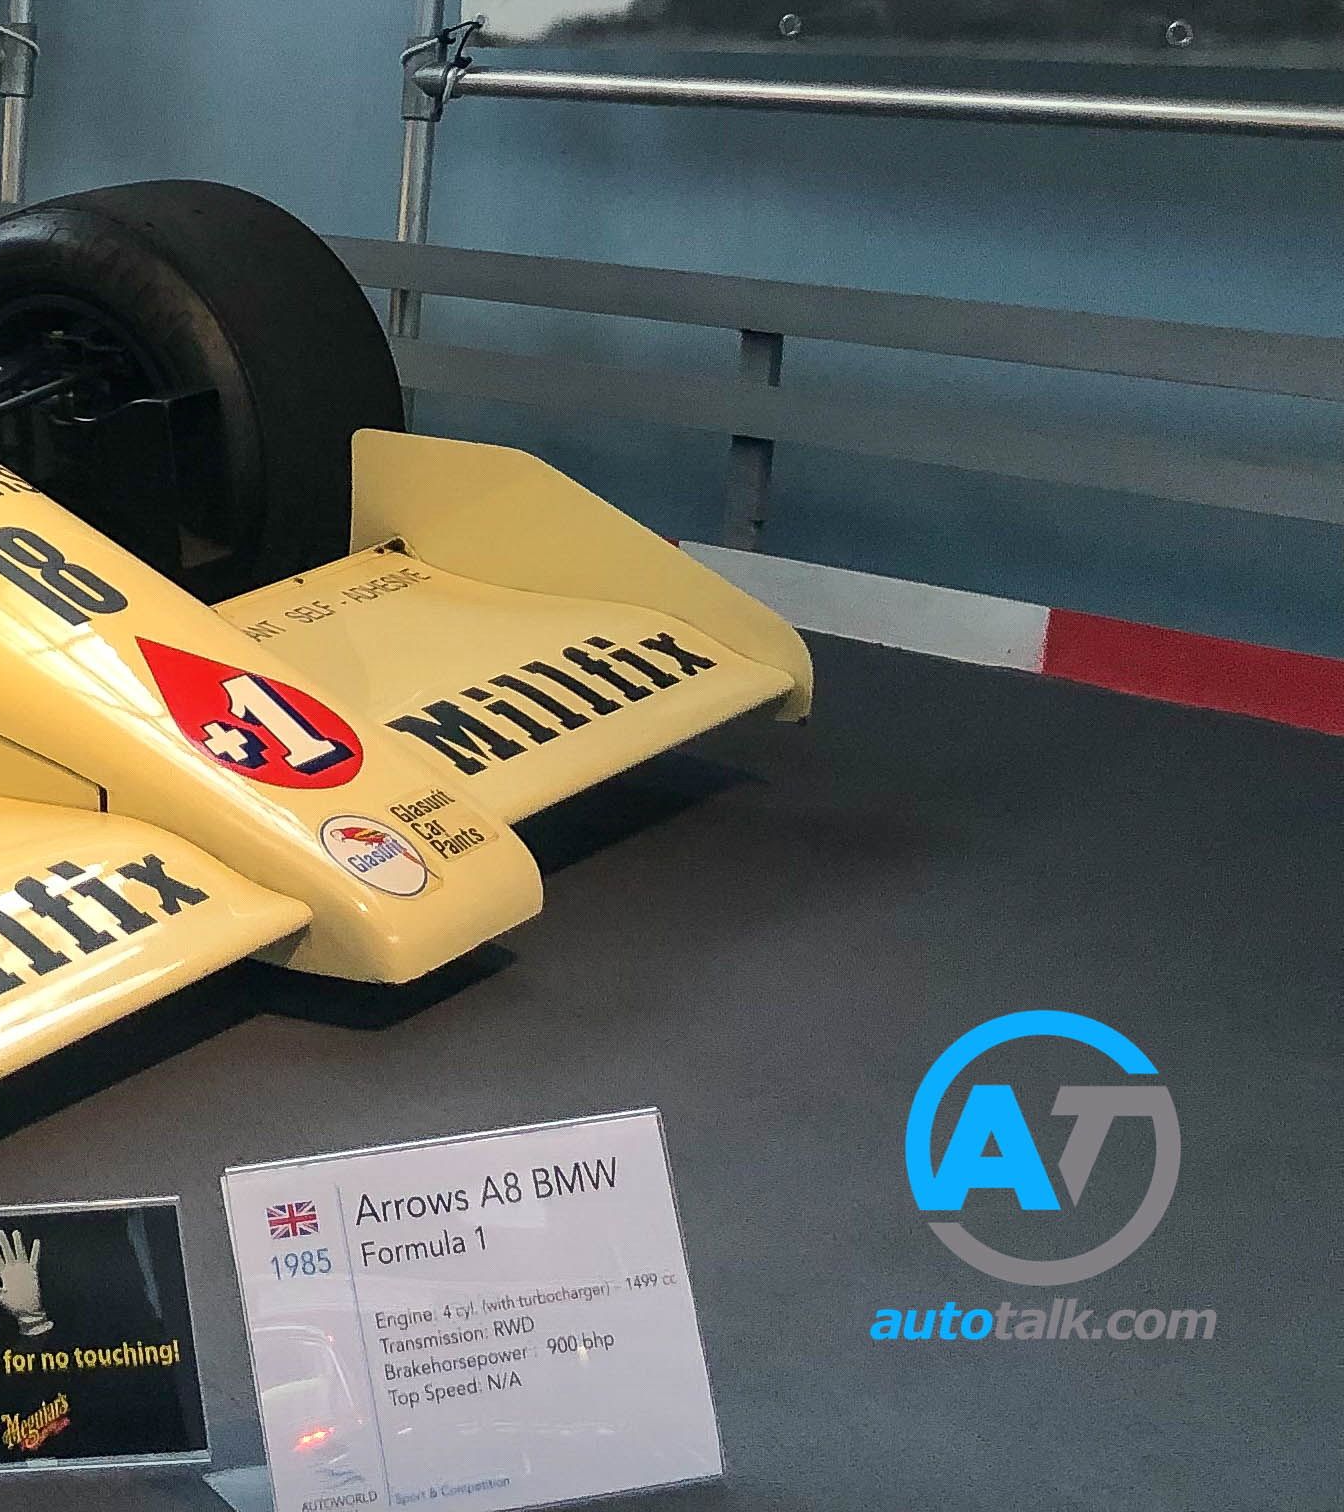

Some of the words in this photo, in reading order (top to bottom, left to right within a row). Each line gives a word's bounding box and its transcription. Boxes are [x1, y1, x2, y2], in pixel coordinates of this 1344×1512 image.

[284, 600, 334, 625] SELF
[350, 568, 432, 605] ADHESIVE
[385, 631, 718, 776] Millfix
[200, 673, 355, 775] +1
[410, 818, 448, 841] Car
[429, 826, 485, 860] Paints
[356, 1189, 469, 1226] Arrows
[480, 1172, 523, 1208] A8
[532, 1157, 617, 1199] BMW
[270, 1248, 333, 1281] 1985
[362, 1230, 467, 1267] Formula
[475, 1225, 487, 1250] 1
[443, 1304, 452, 1319] 4
[483, 1296, 516, 1314] (with
[518, 1281, 611, 1308] turbocharger)
[625, 1273, 658, 1291] 1499
[379, 1327, 489, 1356] Transmission:
[493, 1317, 535, 1338] RWD
[547, 1335, 577, 1355] 900
[583, 1331, 615, 1352] bhp
[3, 1349, 33, 1373] for
[41, 1352, 69, 1370] no
[74, 1339, 181, 1368] touching!
[389, 1389, 420, 1408] Top
[425, 1377, 482, 1404] Speed:
[487, 1371, 522, 1392] N/A
[301, 1491, 378, 1512] AUTOWORLD
